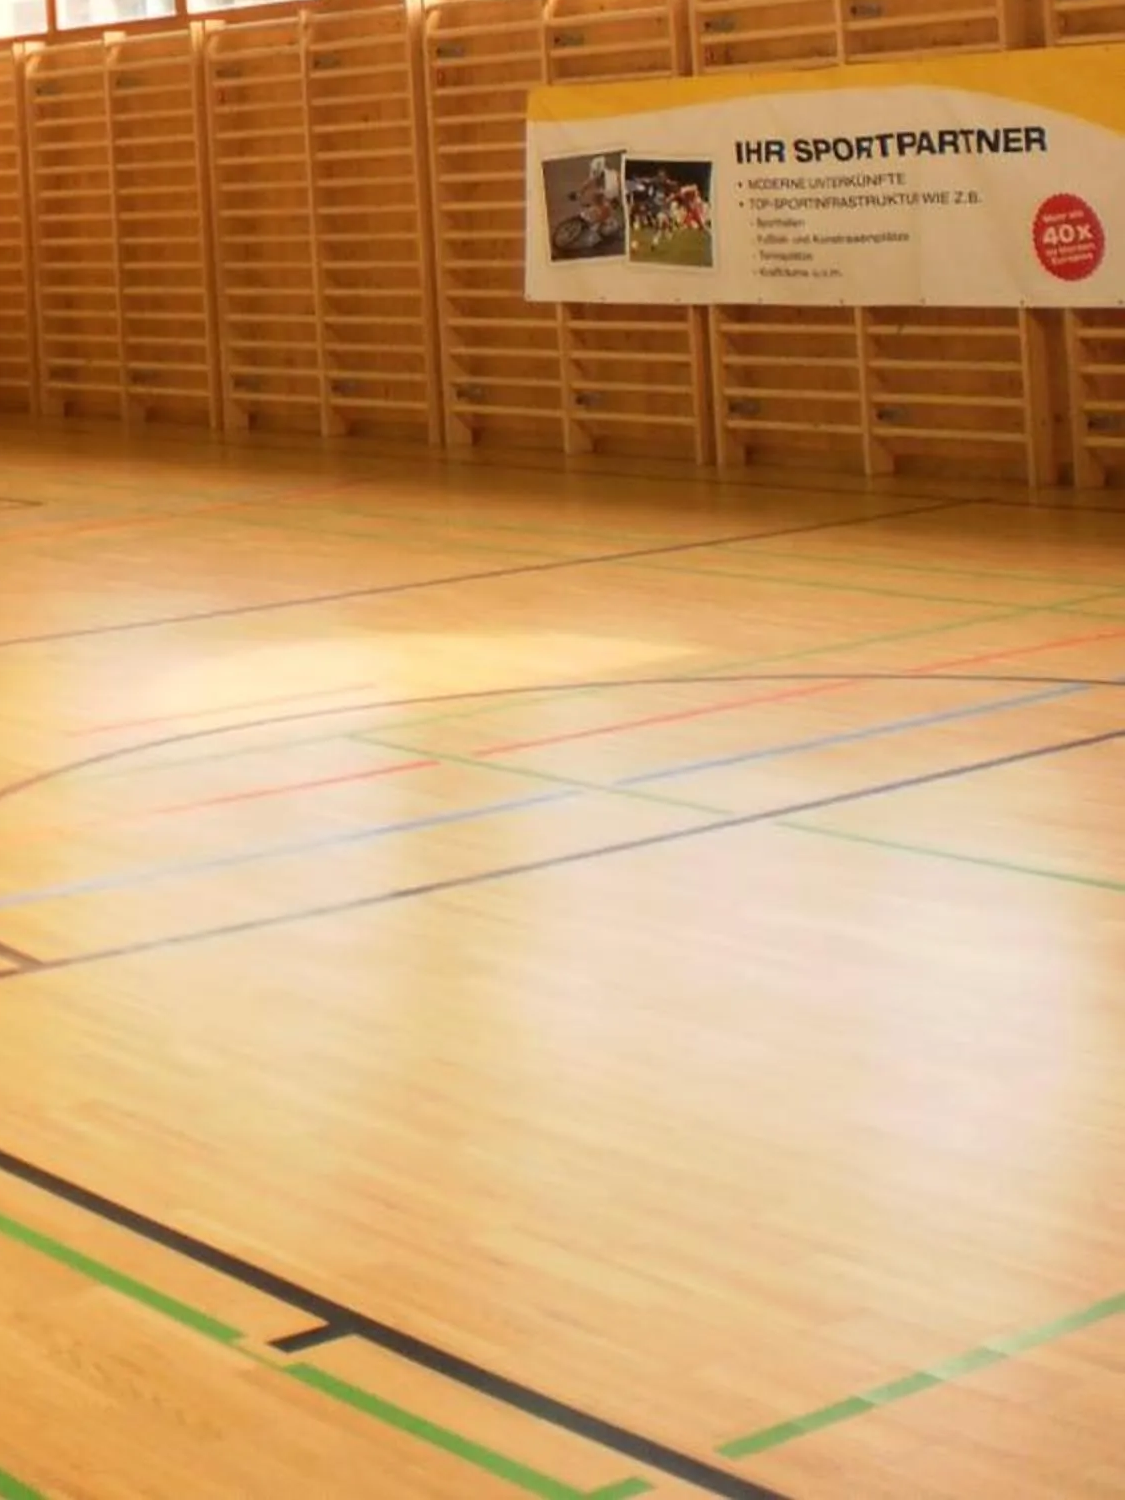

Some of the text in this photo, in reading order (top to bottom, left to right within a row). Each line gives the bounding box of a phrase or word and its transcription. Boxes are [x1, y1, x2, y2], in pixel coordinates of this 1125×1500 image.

[735, 126, 1047, 164] IHR SPORTPARTNER
[921, 190, 950, 205] WIE
